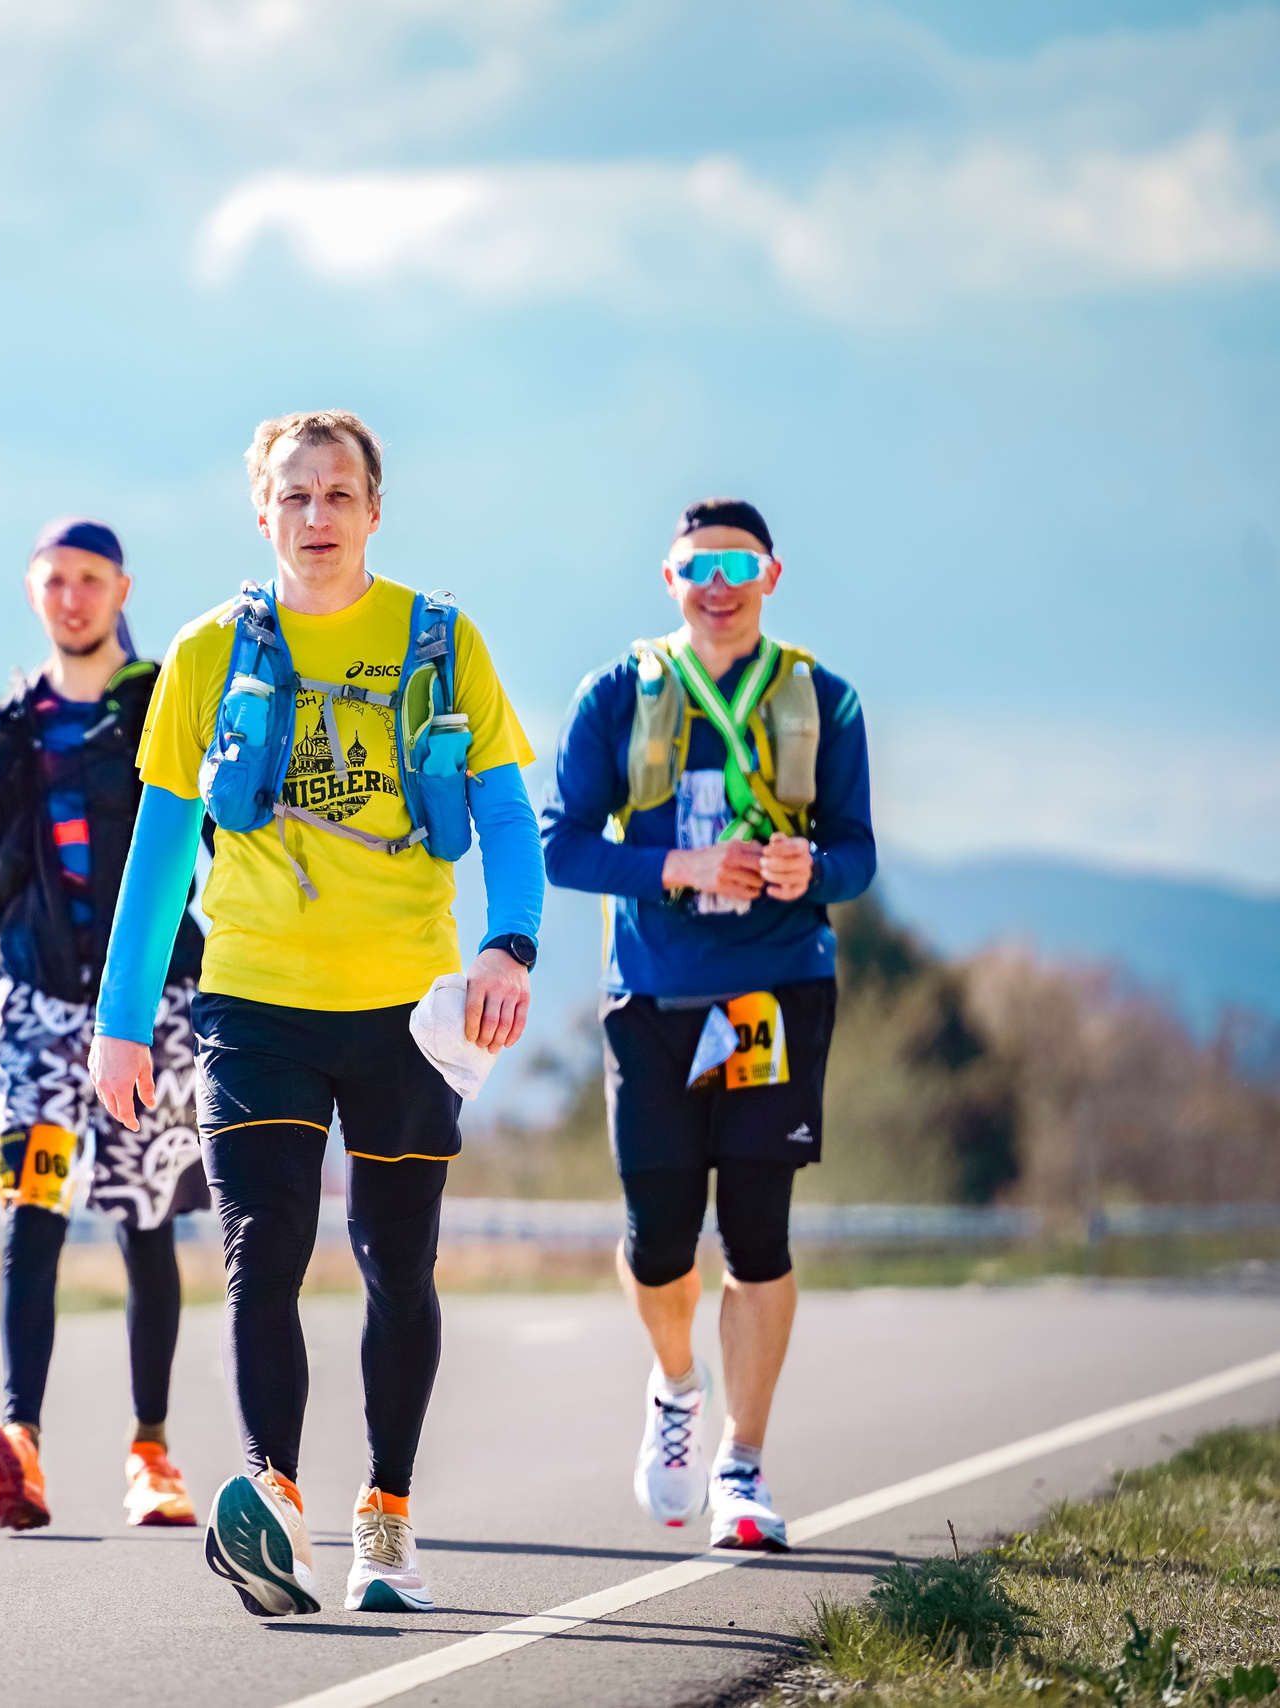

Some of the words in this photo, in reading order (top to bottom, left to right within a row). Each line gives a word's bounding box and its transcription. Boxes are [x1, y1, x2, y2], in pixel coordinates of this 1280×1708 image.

[364, 665, 401, 677] asics
[368, 702, 398, 768] НАРОДНЫЙ
[283, 770, 381, 808] NISHER
